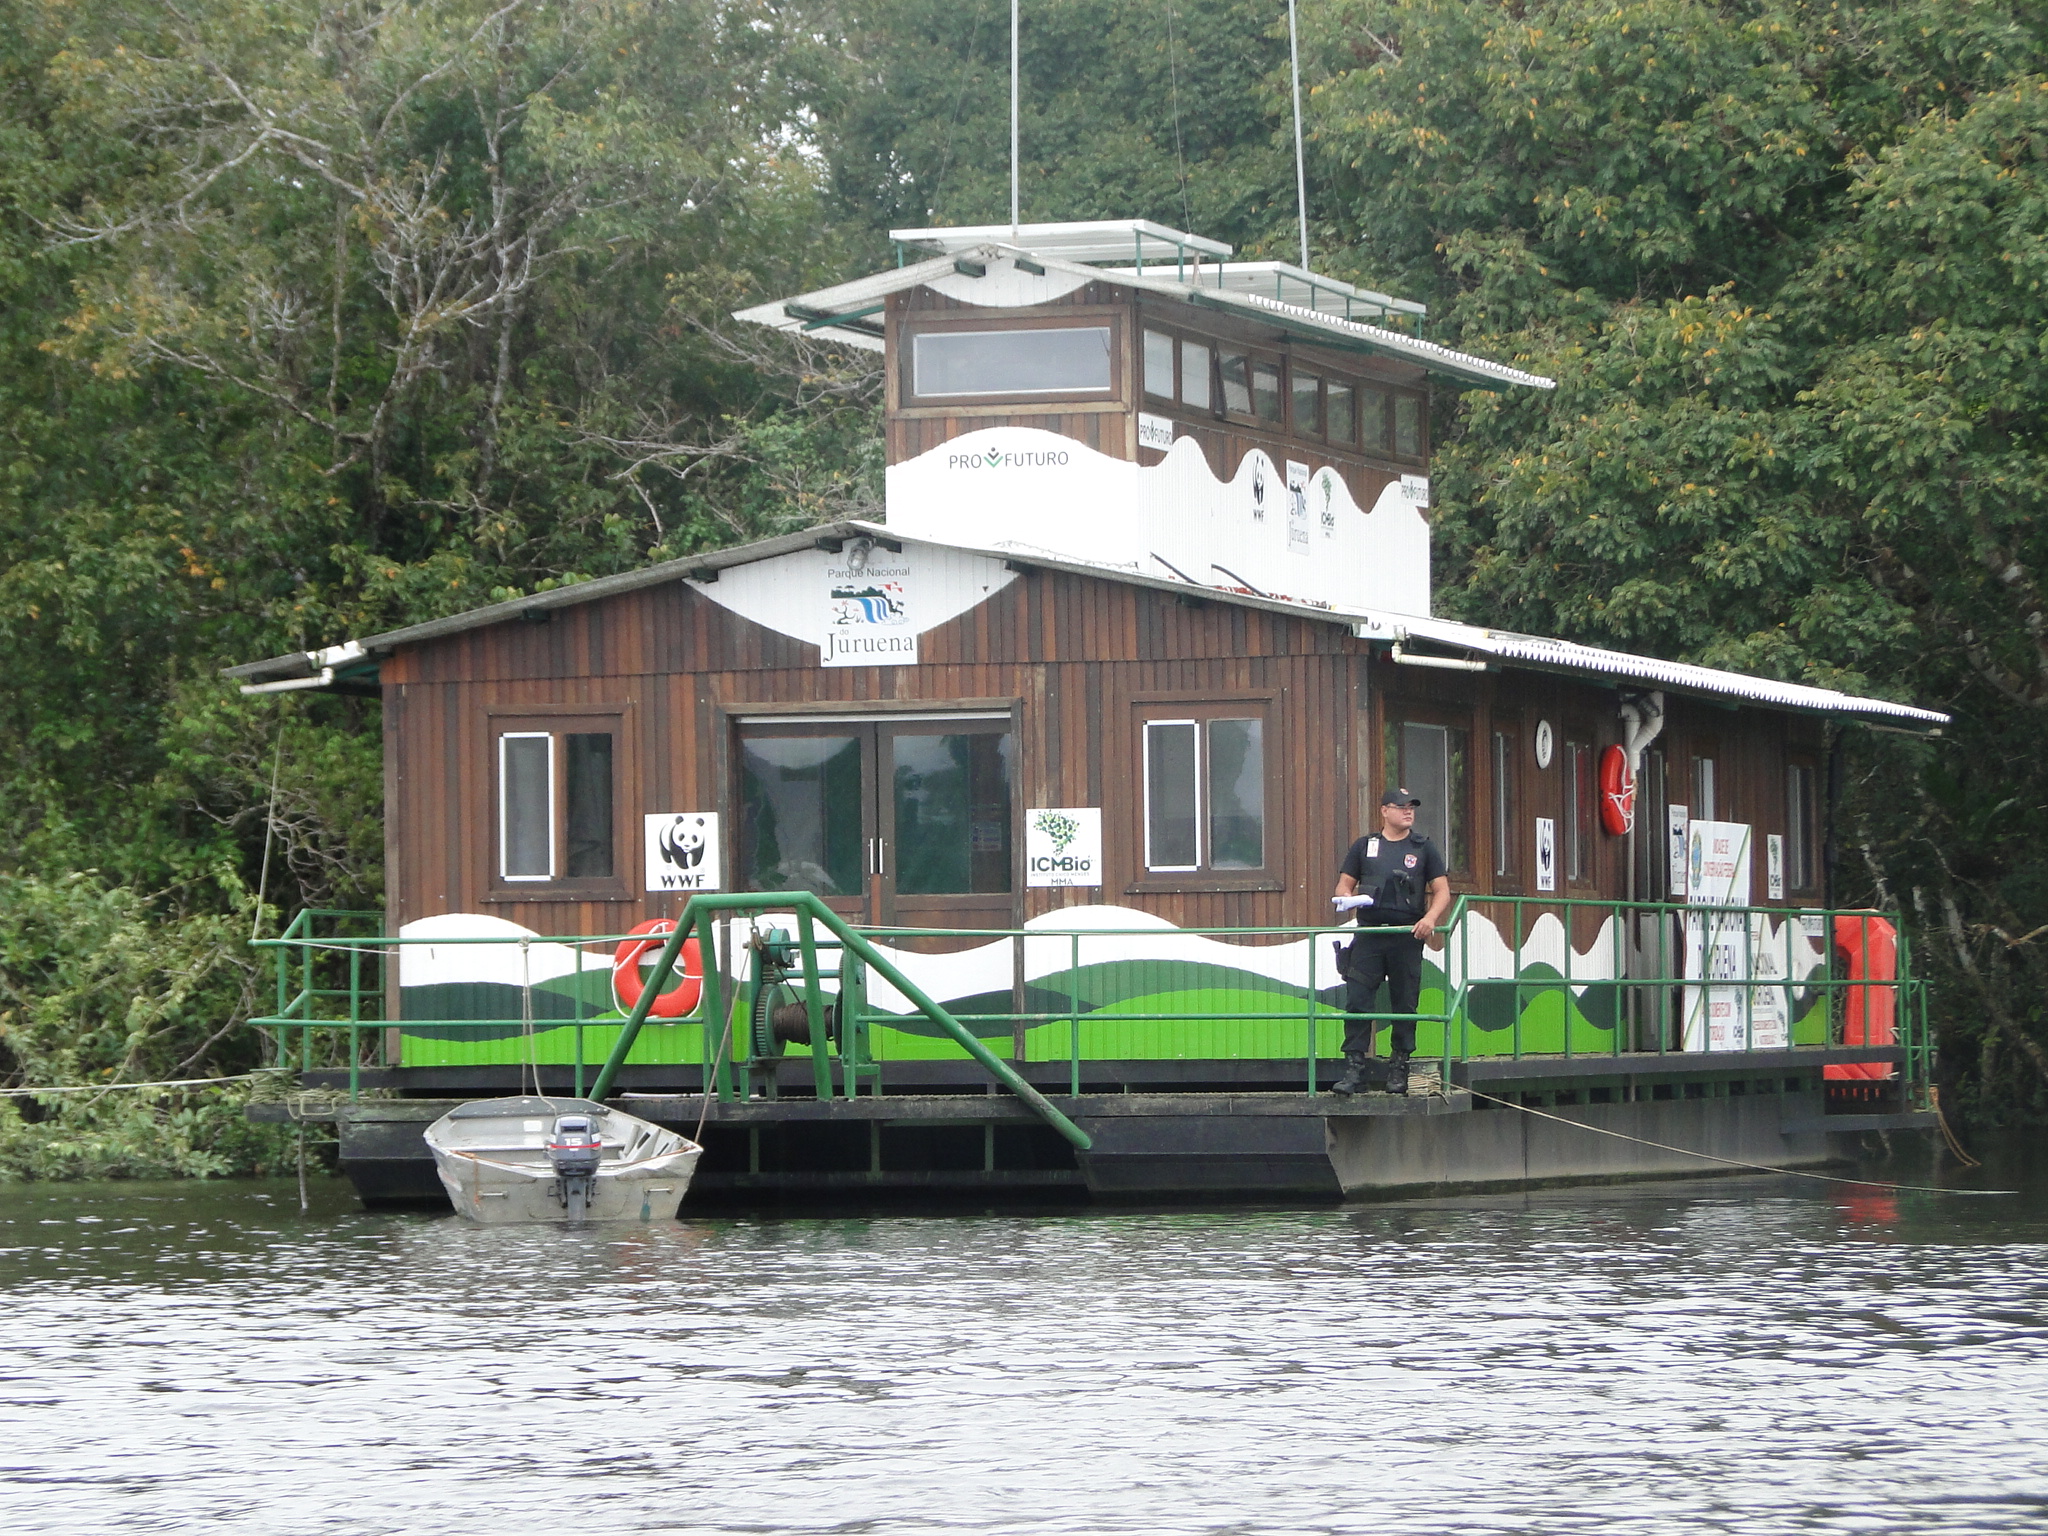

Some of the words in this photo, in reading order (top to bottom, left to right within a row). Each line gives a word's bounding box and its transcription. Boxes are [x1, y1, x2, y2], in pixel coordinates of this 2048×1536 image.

[949, 453, 981, 469] PRO
[1005, 450, 1069, 468] FUTURO
[1253, 509, 1264, 523] WWF
[828, 568, 863, 580] Parque
[866, 566, 910, 577] Nacional
[822, 632, 914, 663] Juruena
[1031, 856, 1091, 872] ICMBio
[660, 874, 705, 888] WWF
[1051, 878, 1073, 886] MMA
[1540, 875, 1551, 889] WWF
[564, 1137, 583, 1146] 15
